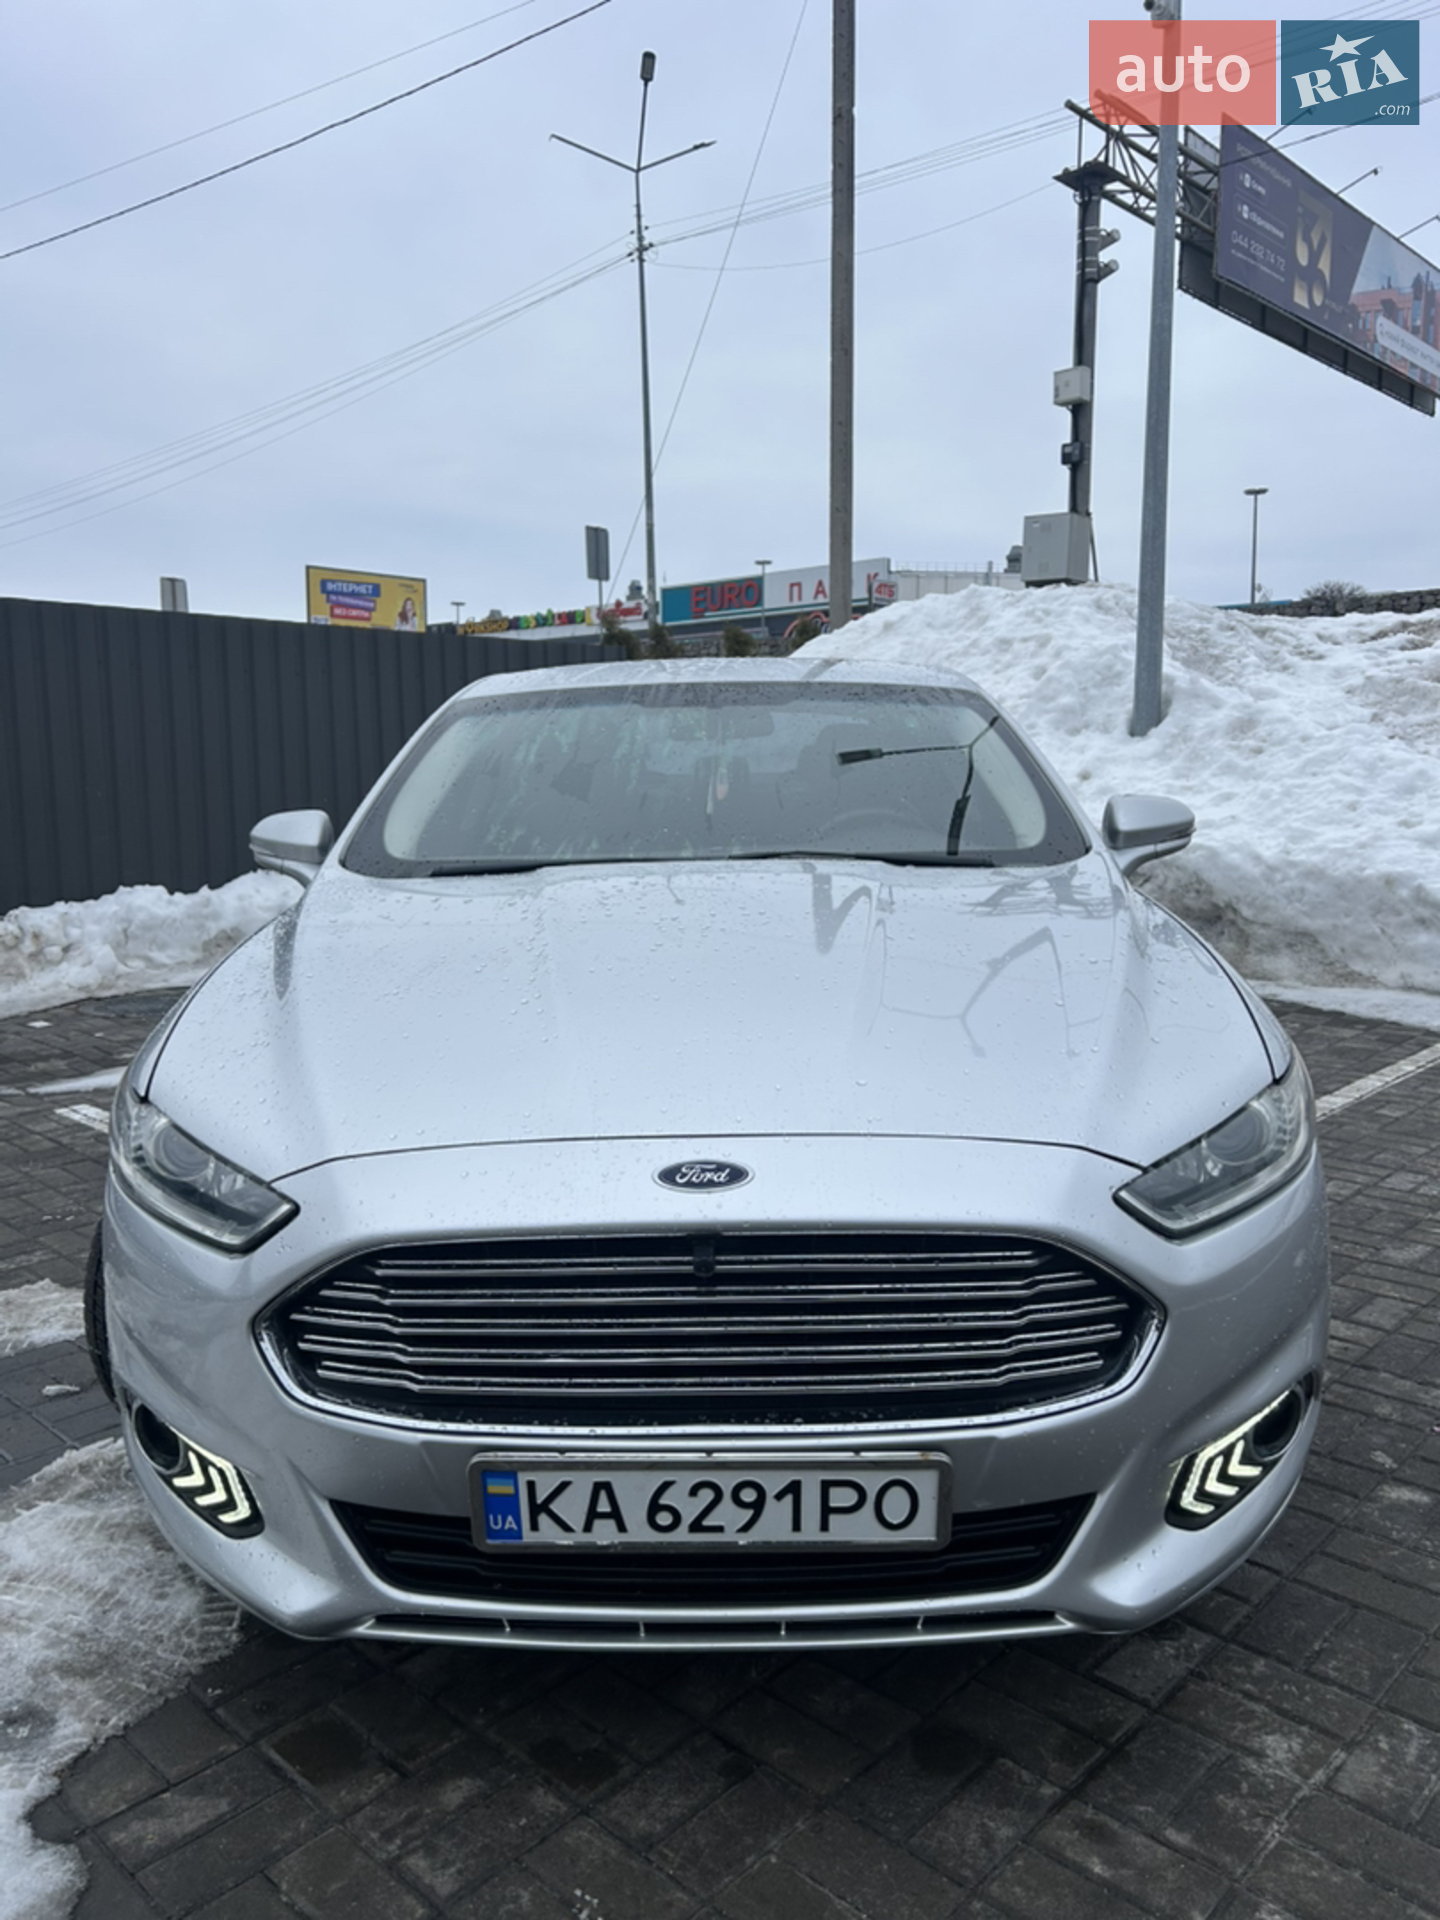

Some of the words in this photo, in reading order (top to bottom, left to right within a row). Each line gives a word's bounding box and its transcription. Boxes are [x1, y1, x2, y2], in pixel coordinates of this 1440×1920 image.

[326, 581, 374, 595] ІНТЕРНЕТ
[691, 579, 760, 613] EURO
[674, 1163, 732, 1184] Ford
[525, 1479, 629, 1534] KA
[489, 1514, 519, 1531] UA
